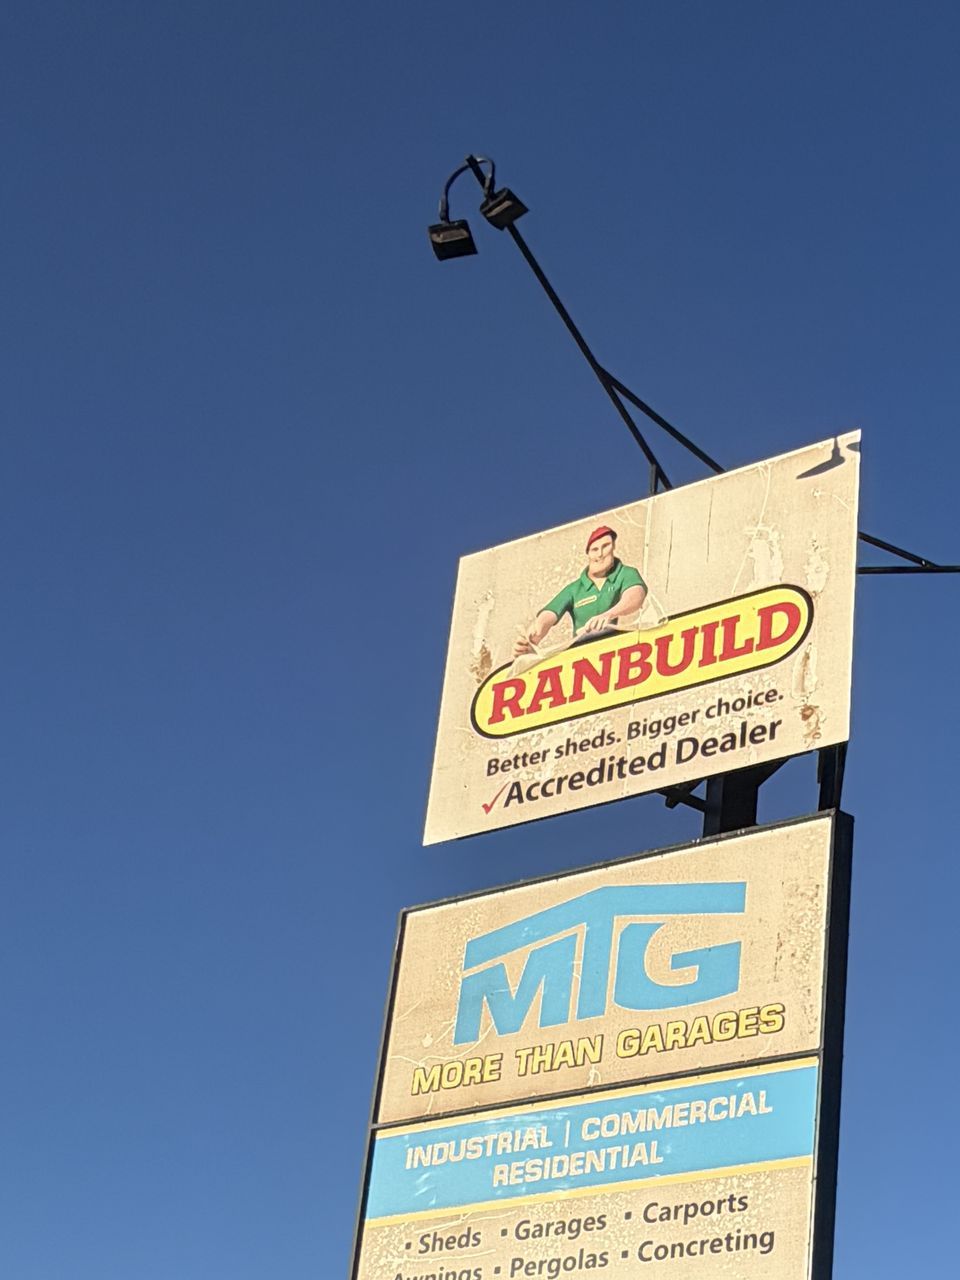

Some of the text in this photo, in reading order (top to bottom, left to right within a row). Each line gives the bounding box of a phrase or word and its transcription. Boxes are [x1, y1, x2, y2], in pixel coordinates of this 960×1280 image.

[487, 601, 801, 725] RANBUILD
[486, 687, 784, 777] Better sheds. Bigger choice.
[504, 717, 783, 808] Accredited Dealer
[453, 882, 746, 1045] MTG
[410, 1003, 785, 1095] MORE THAN GARAGES
[405, 1127, 554, 1170] INDUSTRIAL
[580, 1091, 773, 1142] COMMERCIAL
[492, 1141, 665, 1188] RESIDENTIAL
[418, 1193, 749, 1255] Sheds Garages Carports
[509, 1248, 610, 1280] Pergolas
[637, 1228, 776, 1264] Concreting
